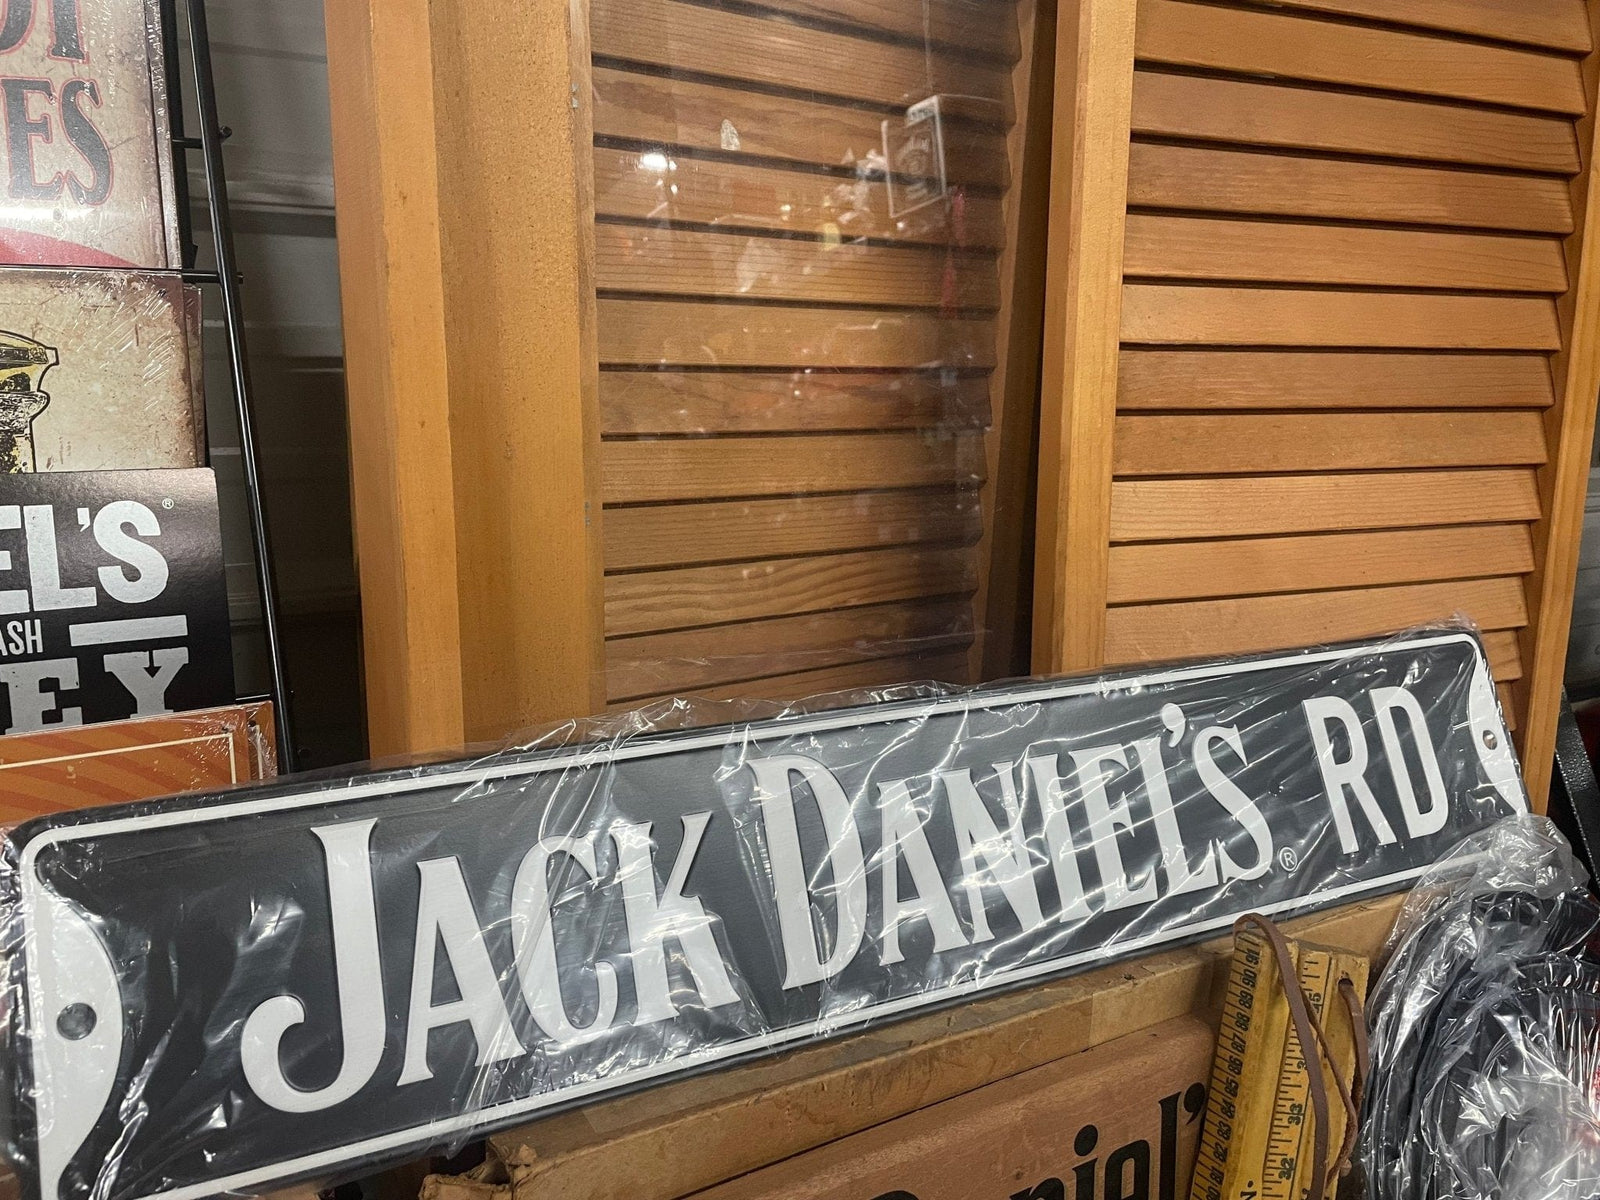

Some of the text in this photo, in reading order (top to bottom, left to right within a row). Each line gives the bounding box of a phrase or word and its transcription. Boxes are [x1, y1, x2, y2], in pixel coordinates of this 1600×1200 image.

[0, 75, 114, 206] ES
[0, 646, 189, 735] EY
[240, 811, 741, 1113] JACK
[1302, 686, 1450, 855] RD
[1245, 949, 1260, 965] 91
[1242, 968, 1257, 988] 90
[1239, 989, 1253, 1009] 89
[1235, 1011, 1250, 1031] 88
[1231, 1032, 1246, 1054] 87
[1227, 1055, 1243, 1075] 86
[1224, 1077, 1239, 1098] 85
[1221, 1099, 1235, 1119] 84
[1217, 1121, 1231, 1140] 83
[1279, 1157, 1294, 1180] 32
[1288, 1103, 1304, 1125] 33
[1213, 1142, 1228, 1163] 82
[1209, 1166, 1224, 1185] 81
